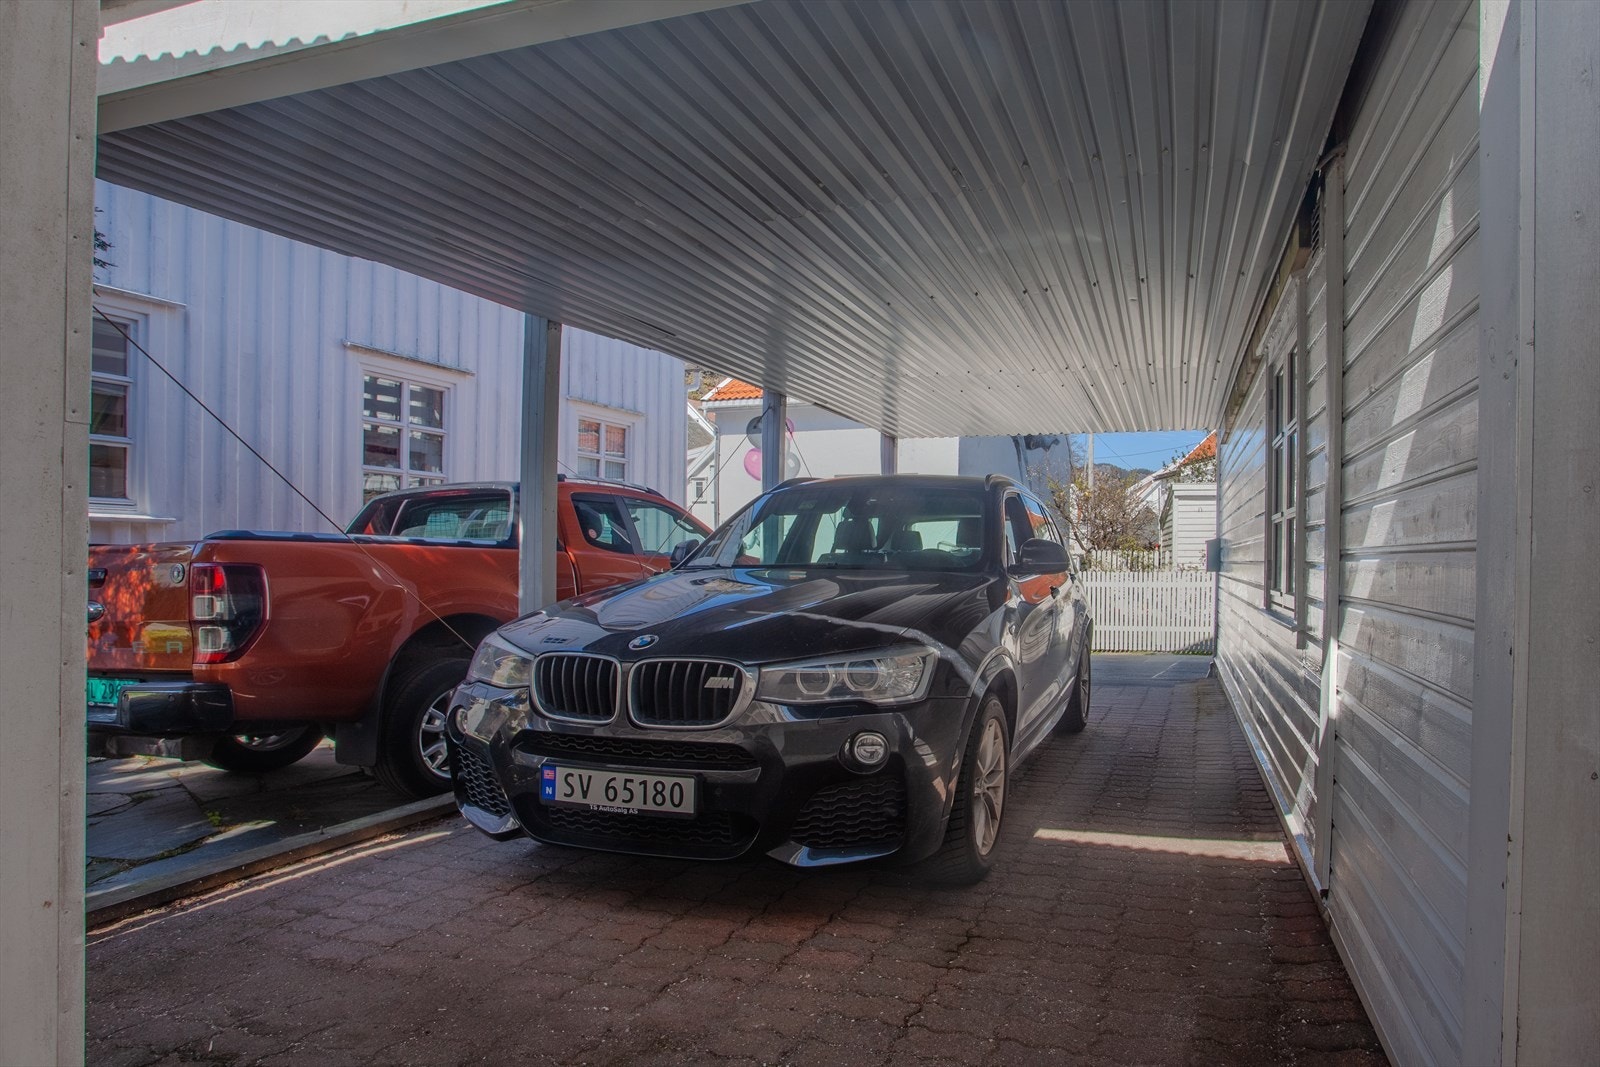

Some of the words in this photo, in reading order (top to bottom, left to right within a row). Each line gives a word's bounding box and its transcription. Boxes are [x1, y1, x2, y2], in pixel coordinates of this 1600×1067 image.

[101, 640, 183, 654] GER
[545, 786, 553, 795] N
[563, 772, 593, 799] SV
[604, 776, 684, 808] 65180
